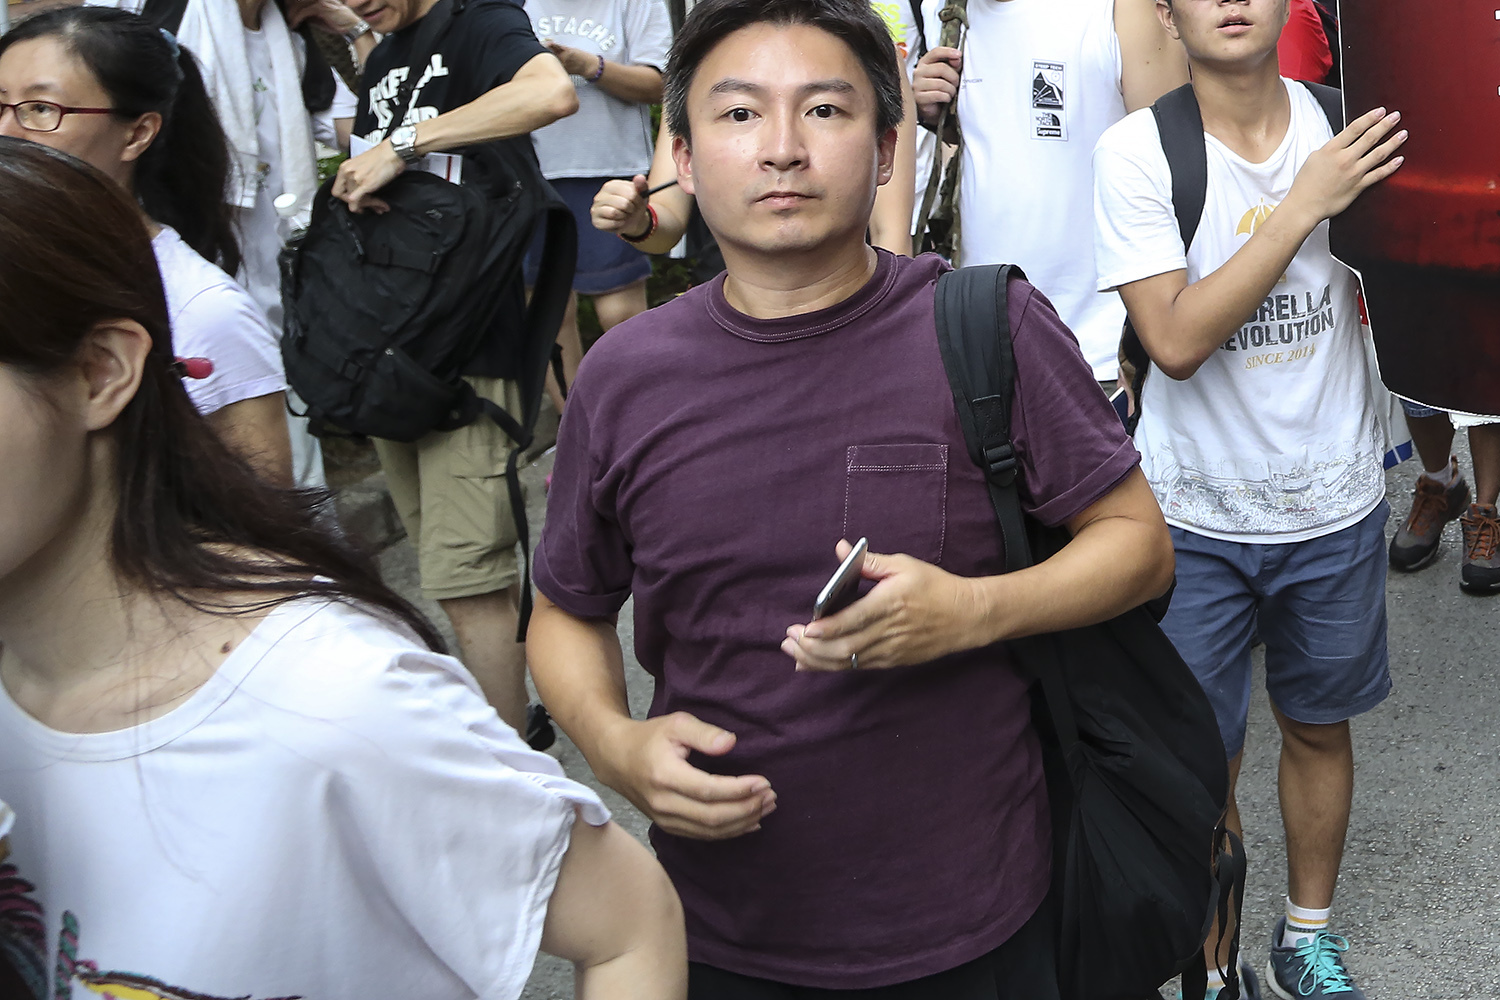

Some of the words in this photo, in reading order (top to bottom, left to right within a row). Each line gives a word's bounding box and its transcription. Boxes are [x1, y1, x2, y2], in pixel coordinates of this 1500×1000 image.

[1219, 307, 1334, 351] EVOLUTION
[1245, 350, 1284, 369] SINCE
[1286, 343, 1315, 362] 2014
